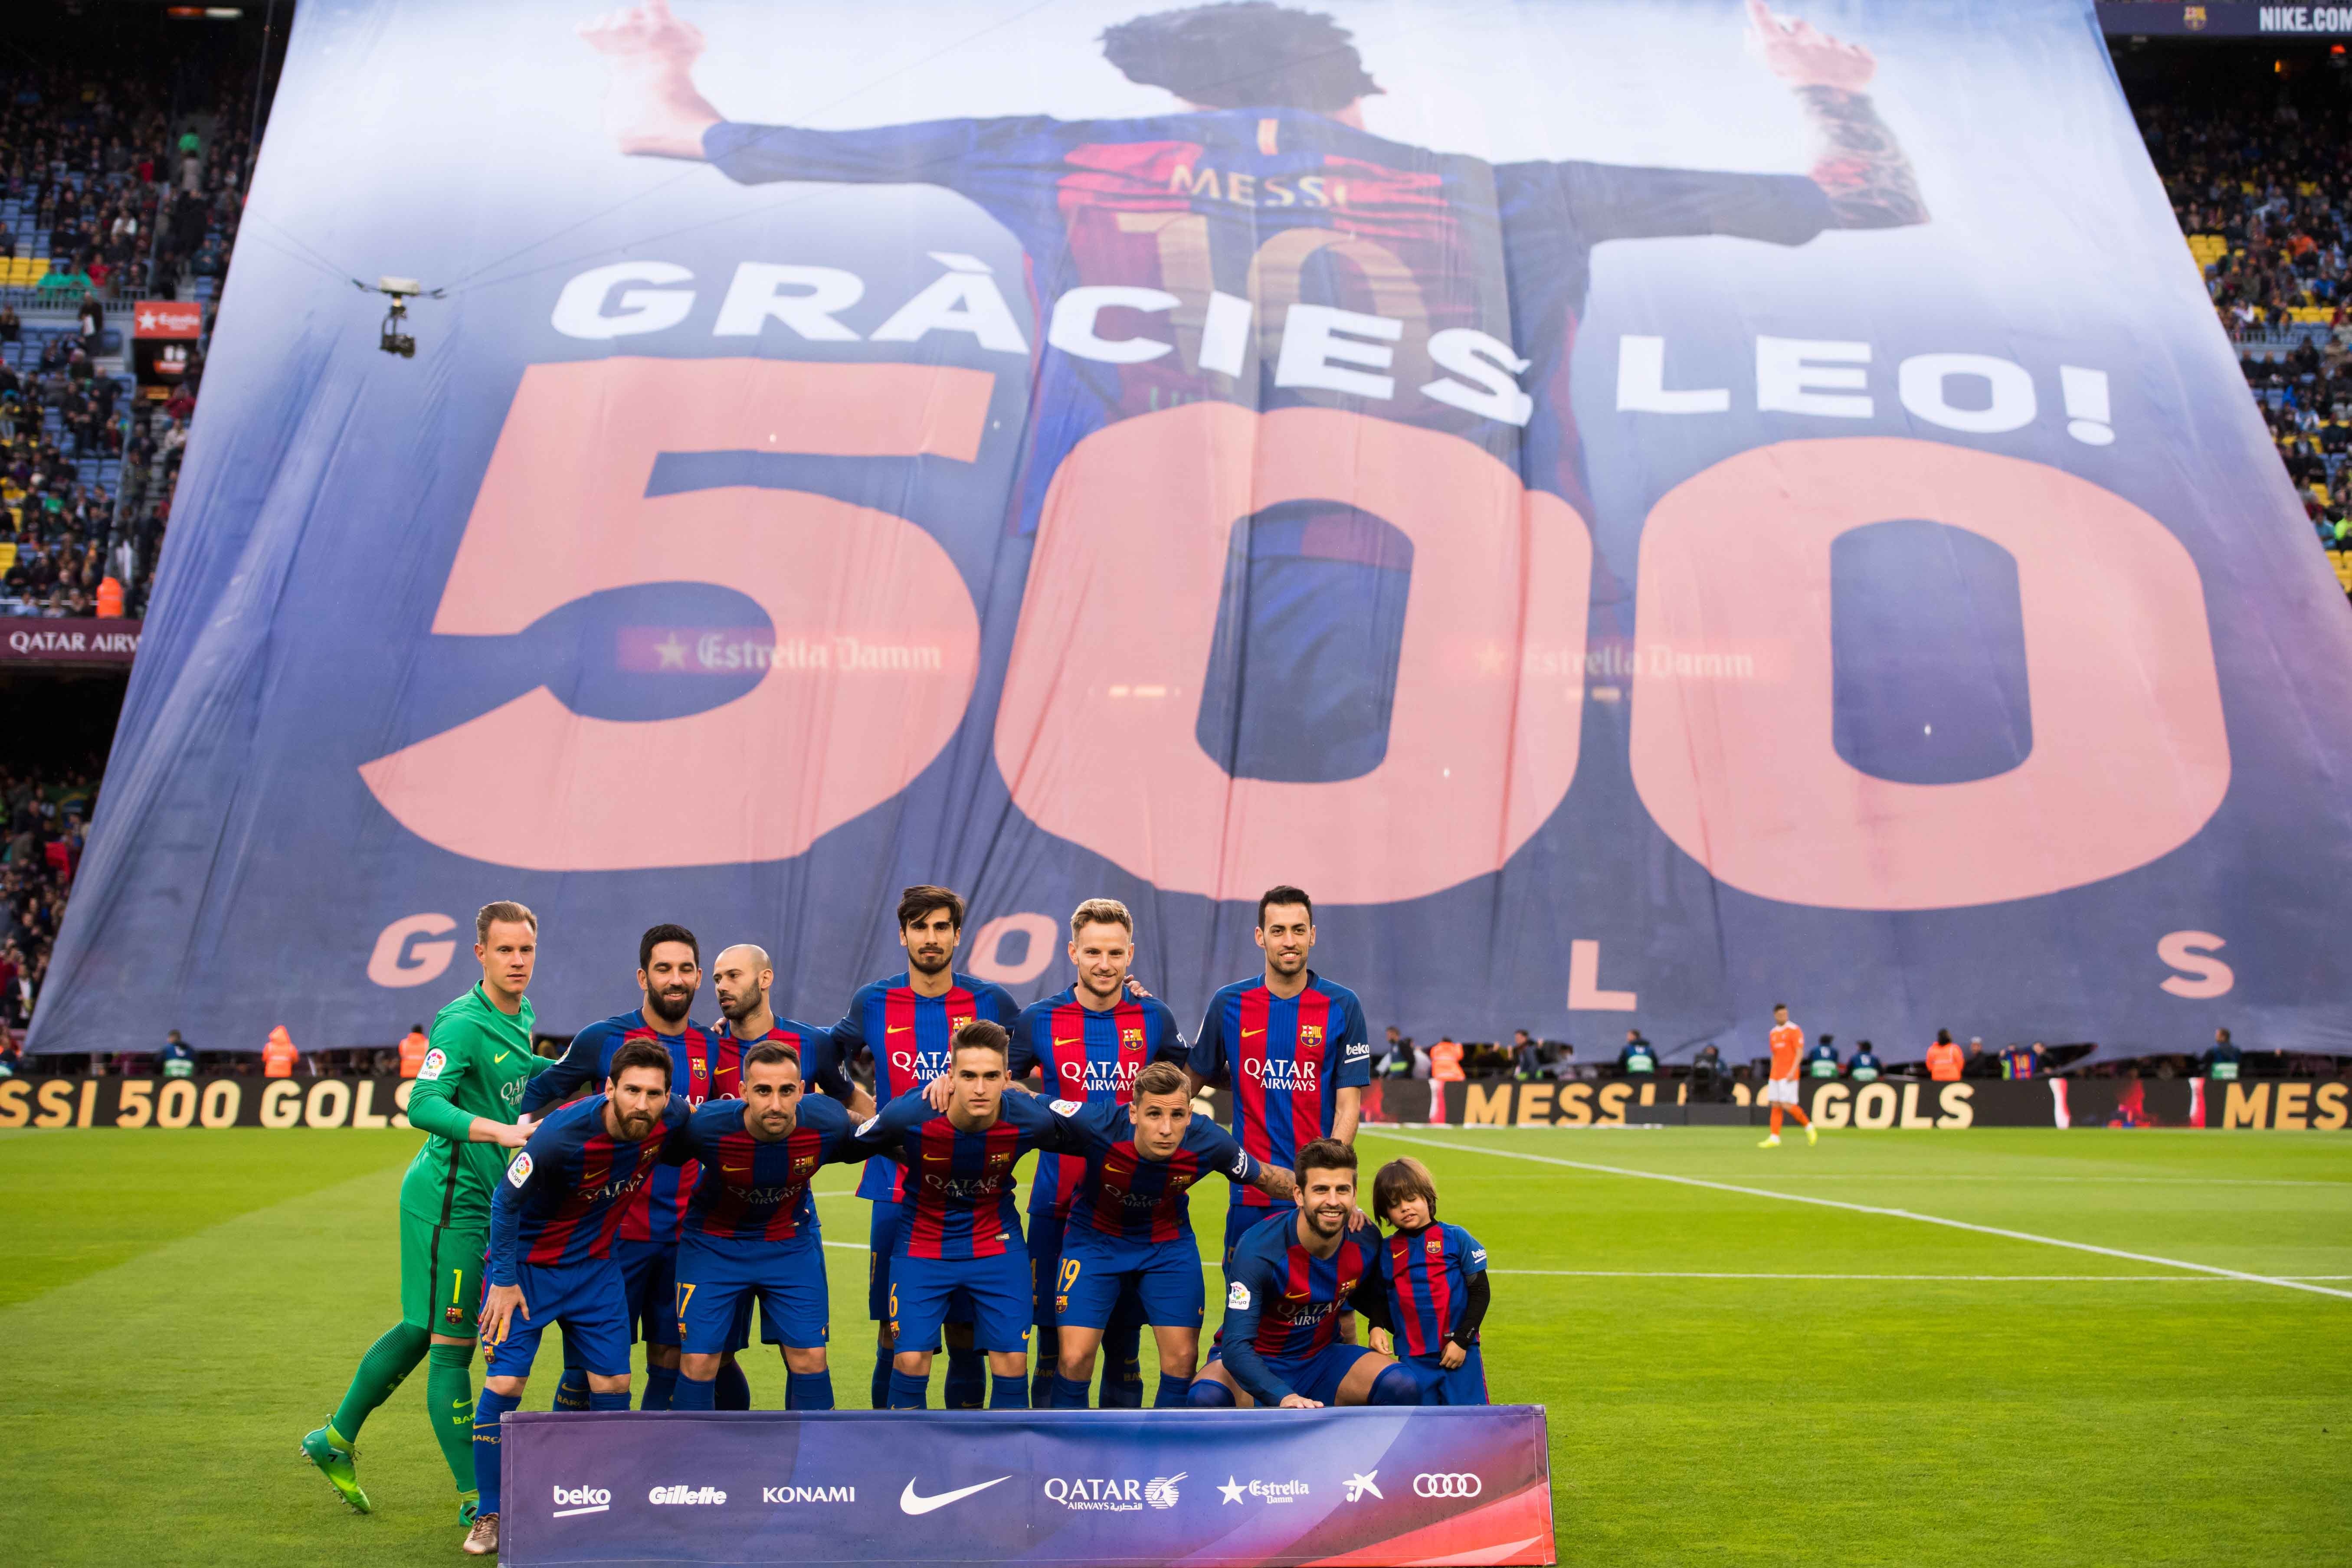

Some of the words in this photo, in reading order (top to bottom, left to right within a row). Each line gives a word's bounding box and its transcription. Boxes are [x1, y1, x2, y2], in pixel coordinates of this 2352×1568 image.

[2259, 7, 2352, 32] NIKE.COM
[1170, 164, 1347, 207] MESSI
[551, 251, 1534, 427] GRÀCIES
[1616, 334, 2116, 446] LEO!
[10, 631, 86, 653] QATAR
[361, 357, 2232, 911] 500
[1346, 1043, 1370, 1055] beko
[892, 1051, 951, 1071] QATA
[1244, 1058, 1316, 1079] QATAR
[501, 1076, 528, 1100] QAT
[1081, 1080, 1135, 1090] AIRWAY
[1260, 1079, 1316, 1091] AIRWAYS
[116, 1079, 241, 1129] 500
[1811, 1082, 1975, 1129] GOLS
[2222, 1082, 2349, 1130] MES
[1471, 1249, 1486, 1259] beko
[1056, 1259, 1081, 1291] 19
[453, 1269, 462, 1304] 1
[889, 1283, 898, 1317] 6
[553, 1485, 611, 1505] beko
[649, 1486, 727, 1505] Gillette
[763, 1486, 856, 1503] KONAMI
[1044, 1478, 1142, 1505] QATAR
[1248, 1479, 1310, 1496] Estrella
[1067, 1502, 1110, 1510] AIRWAYS
[1110, 1503, 1143, 1512] القطرية
[1266, 1496, 1293, 1504] Damm
